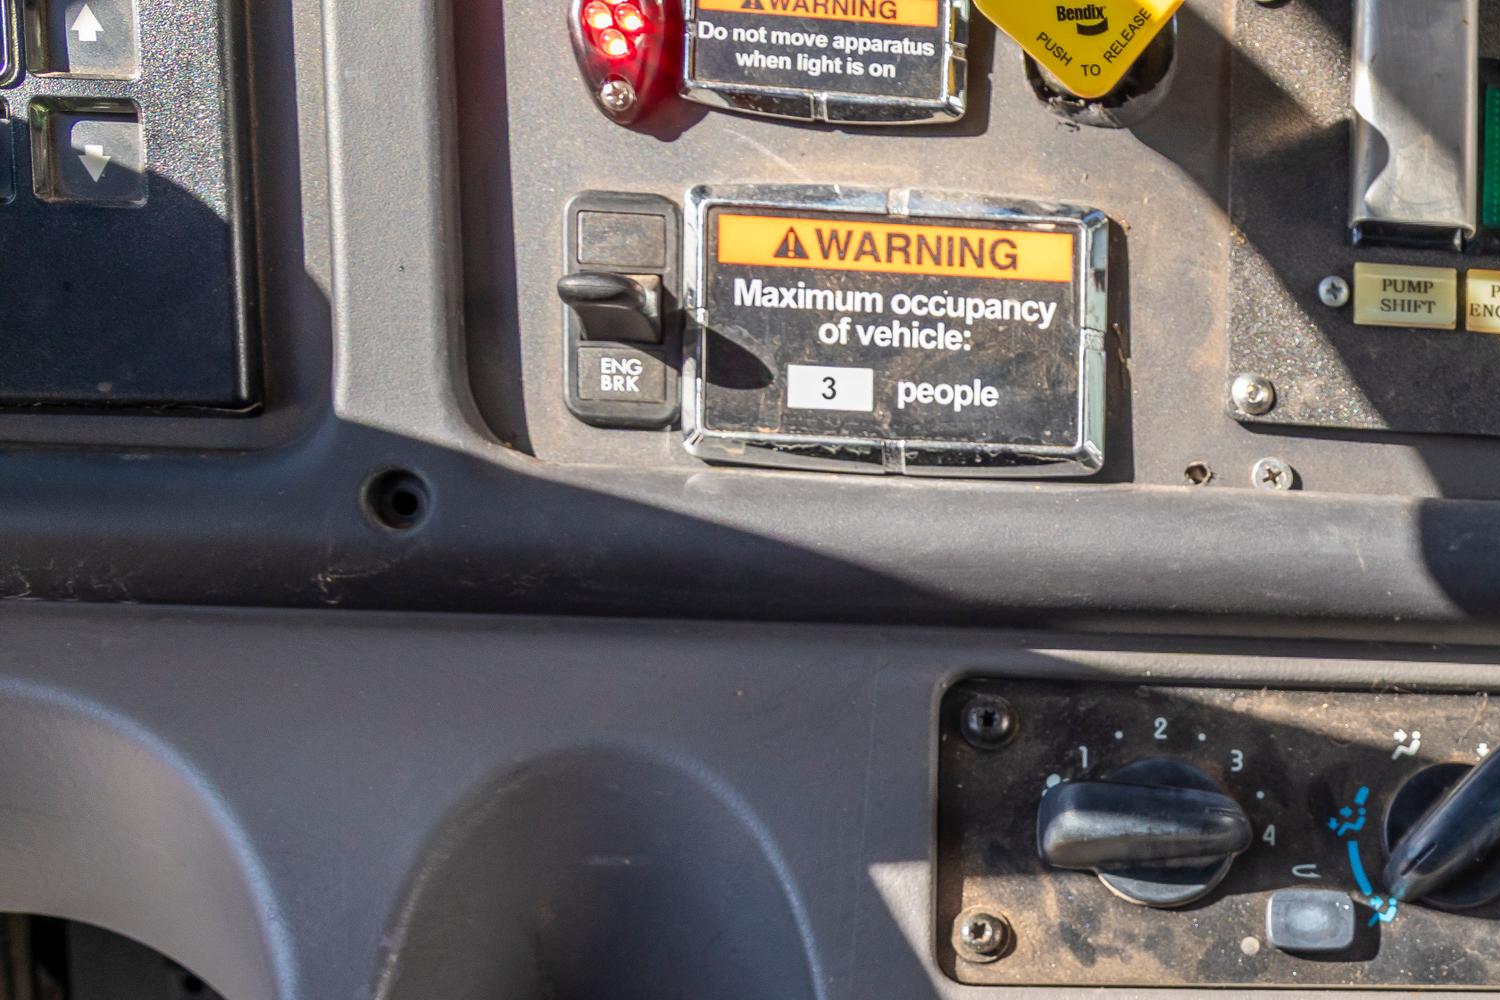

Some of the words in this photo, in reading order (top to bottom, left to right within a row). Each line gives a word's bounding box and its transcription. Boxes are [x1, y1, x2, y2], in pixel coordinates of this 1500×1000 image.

[1056, 4, 1105, 21] Bendix
[697, 21, 728, 40] Do
[732, 26, 767, 44] not
[770, 31, 828, 48] move
[832, 35, 936, 57] apparatus
[1036, 32, 1073, 66] PUSH
[1080, 64, 1102, 77] TO
[1103, 7, 1152, 64] RELEASE
[735, 51, 792, 70] when
[796, 53, 843, 76] light
[846, 57, 864, 74] is
[868, 62, 896, 78] on
[815, 227, 1020, 271] WARNING
[733, 278, 884, 313] Maximum
[889, 290, 1057, 330] occupancy
[1381, 279, 1435, 296] PUMP
[1380, 299, 1436, 315] SHIFT
[818, 317, 852, 346] of
[856, 322, 972, 352] vehicle:
[600, 357, 643, 374] ENG
[600, 375, 640, 393] BRK
[820, 376, 837, 401] 3
[897, 379, 1000, 412] people
[1078, 745, 1089, 769] 1
[1153, 717, 1169, 740] 2
[1230, 749, 1244, 772] 3
[1262, 823, 1277, 847] 4
